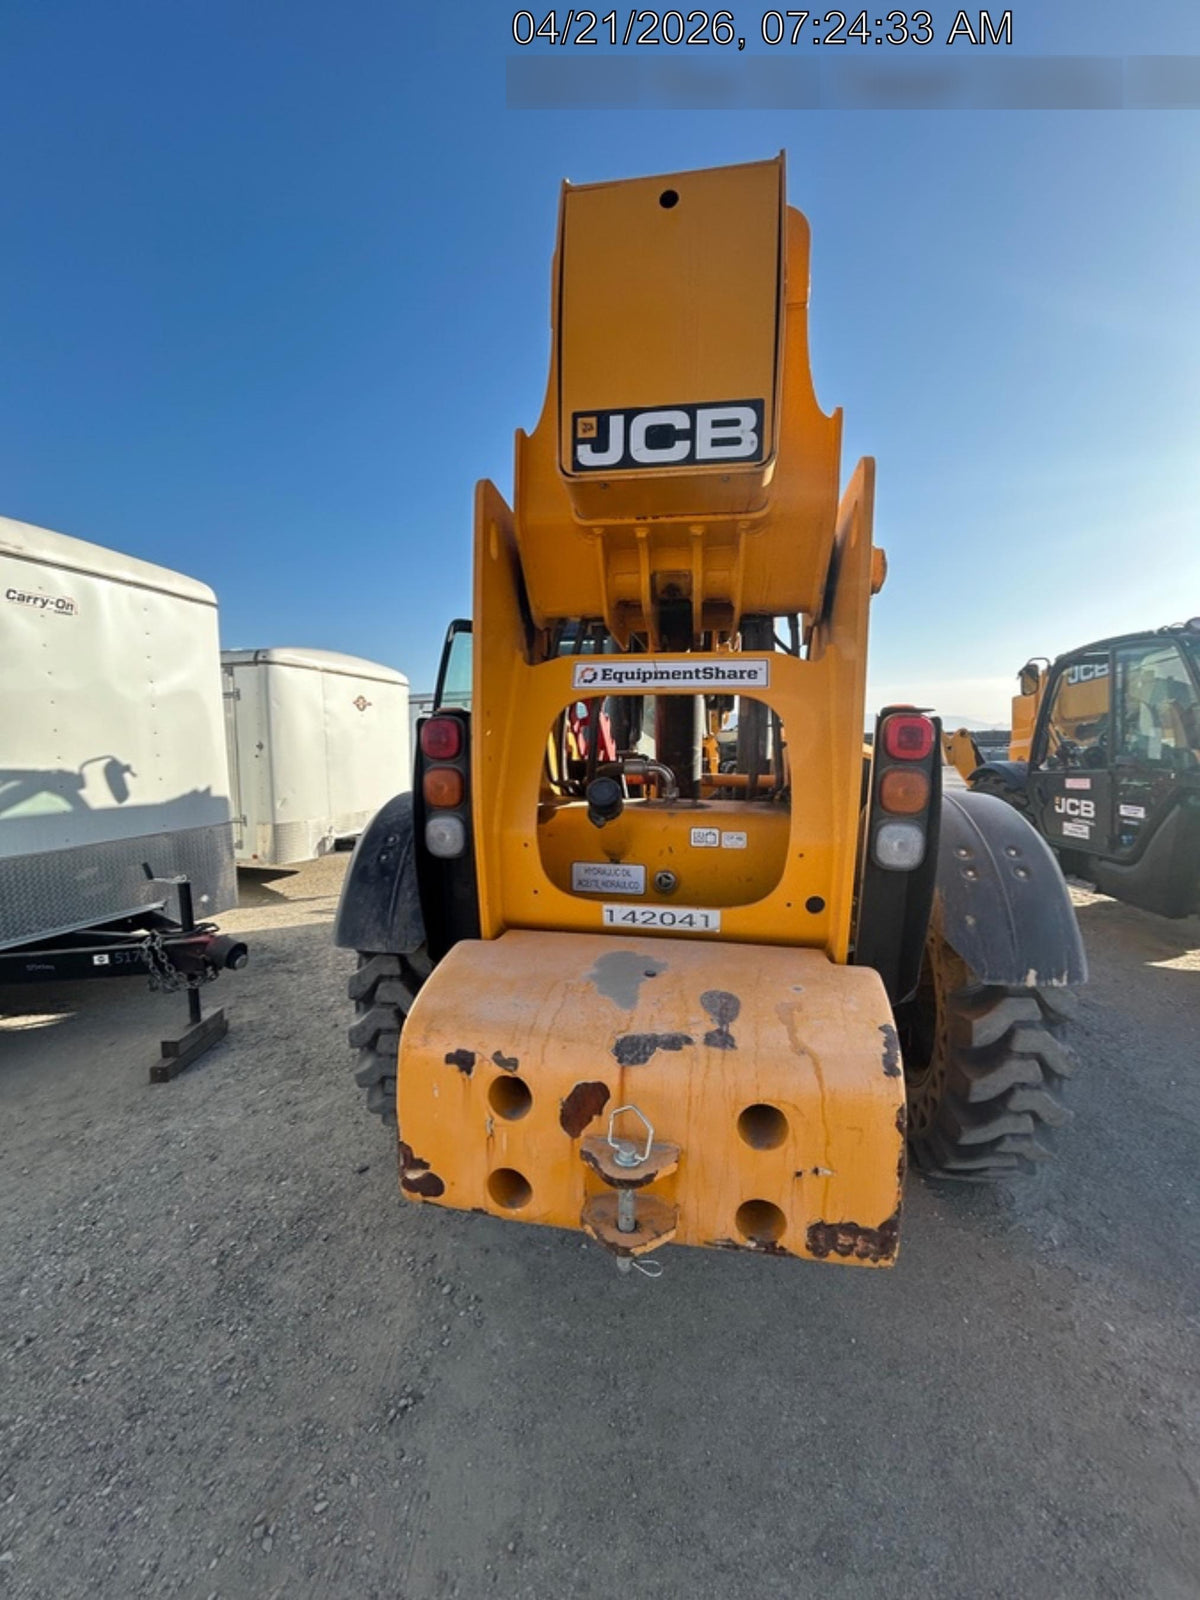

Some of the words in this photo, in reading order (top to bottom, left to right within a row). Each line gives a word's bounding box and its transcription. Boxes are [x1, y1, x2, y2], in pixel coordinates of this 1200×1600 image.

[576, 406, 758, 467] JCB
[5, 588, 74, 611] Carry-On
[600, 667, 758, 683] EquipmentShare
[1054, 797, 1095, 818] JCB
[605, 908, 709, 928] 142041
